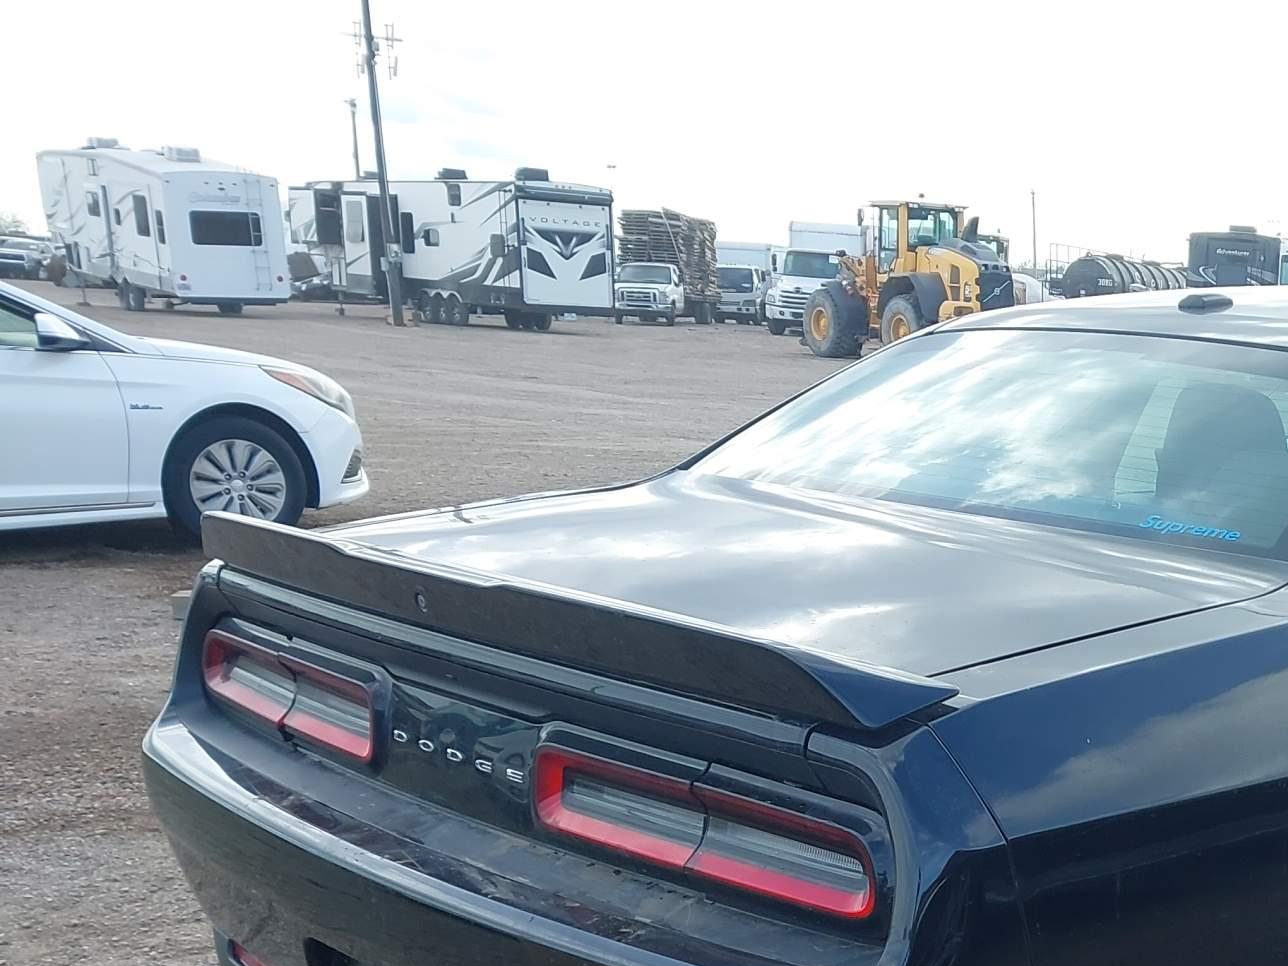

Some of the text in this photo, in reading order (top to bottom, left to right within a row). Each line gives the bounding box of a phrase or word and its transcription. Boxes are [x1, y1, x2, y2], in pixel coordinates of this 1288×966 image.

[528, 216, 602, 228] VOLTAGE
[1140, 515, 1241, 541] Supreme
[393, 729, 524, 784] DODGE
